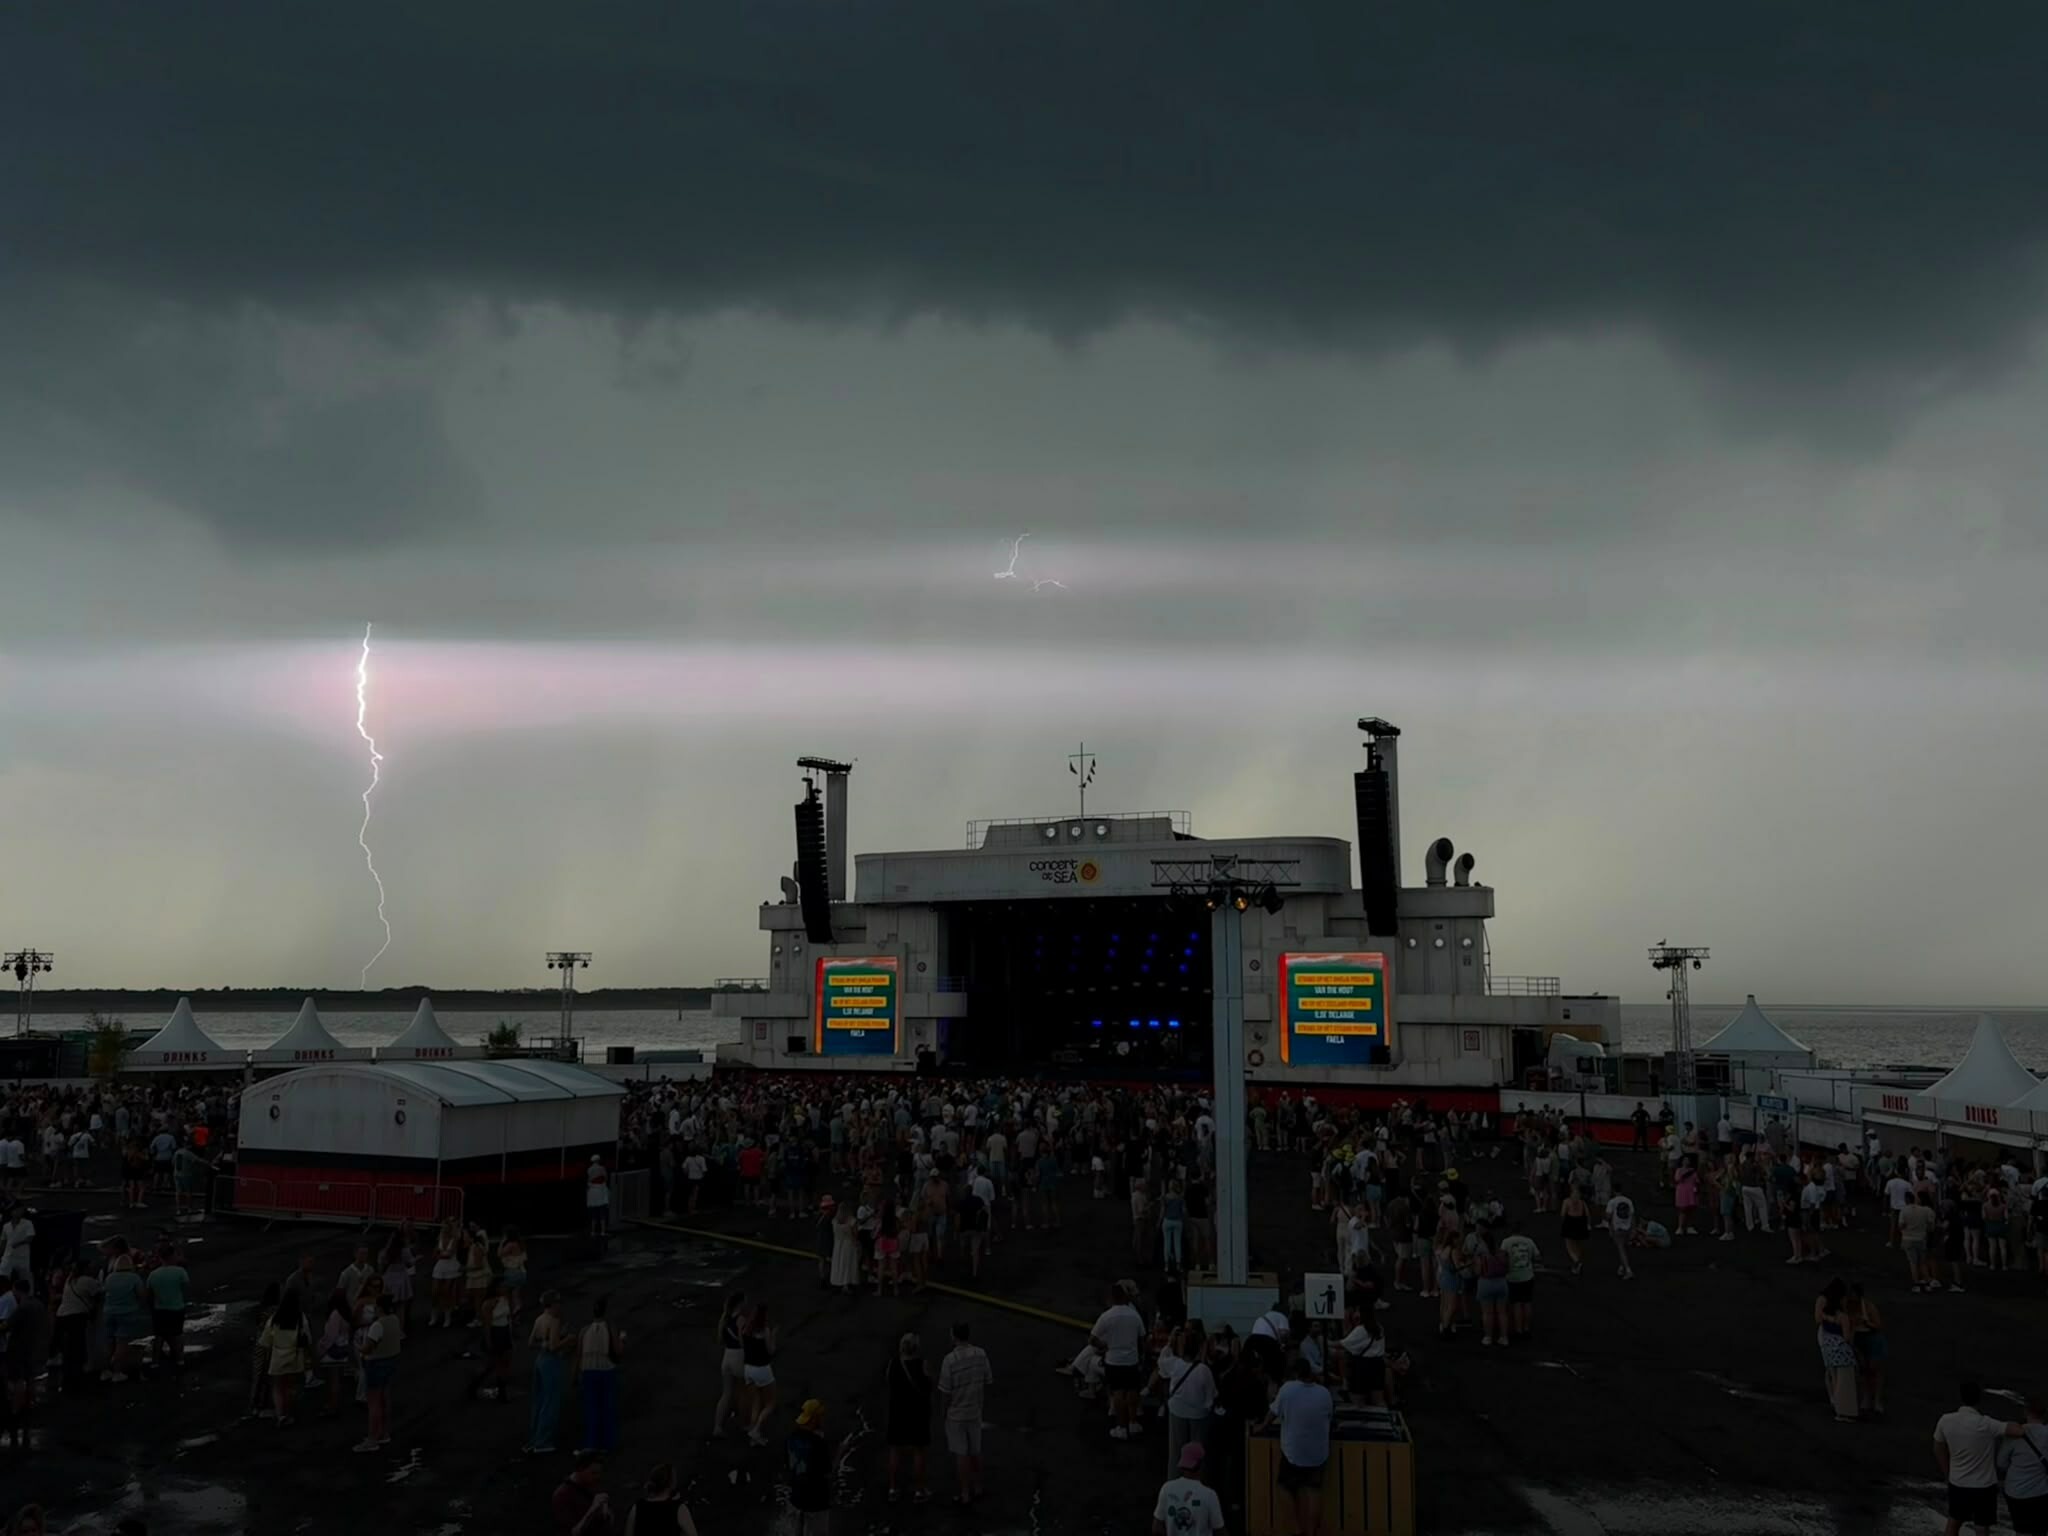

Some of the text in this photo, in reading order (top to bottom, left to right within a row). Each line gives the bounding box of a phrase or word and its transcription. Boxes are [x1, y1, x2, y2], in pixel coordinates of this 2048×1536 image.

[1029, 858, 1078, 871] concert
[1042, 871, 1078, 883] at SEA
[163, 1051, 207, 1063] DRINKS
[295, 1049, 335, 1060] DRINKS
[415, 1047, 454, 1058] DRINKS
[1882, 1094, 1909, 1111] DRINKS
[1965, 1105, 1998, 1125] DRINKS
